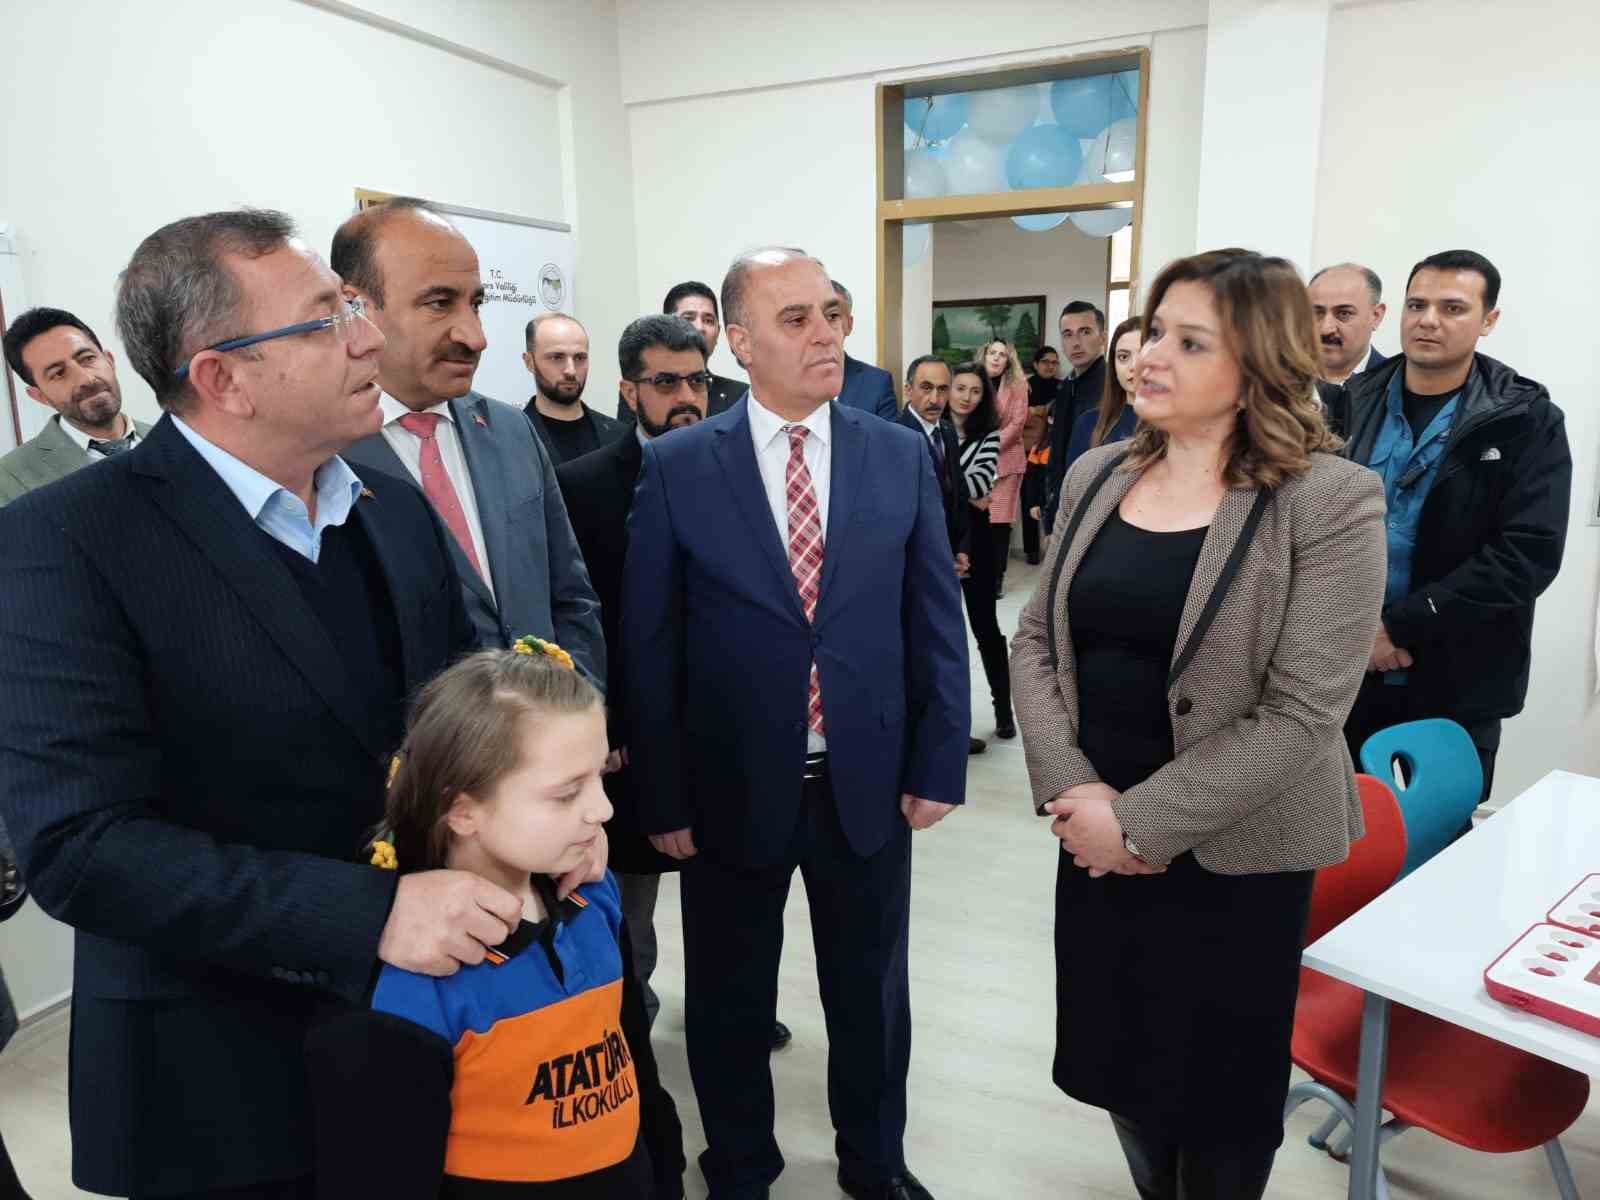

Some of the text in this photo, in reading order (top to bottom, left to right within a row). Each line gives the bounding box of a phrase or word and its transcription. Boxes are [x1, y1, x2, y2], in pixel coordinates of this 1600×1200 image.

[490, 269, 504, 280] T.C.
[484, 294, 501, 304] ğitim
[523, 1028, 631, 1106] ATATÜR
[552, 1073, 633, 1129] İLKOKULU
